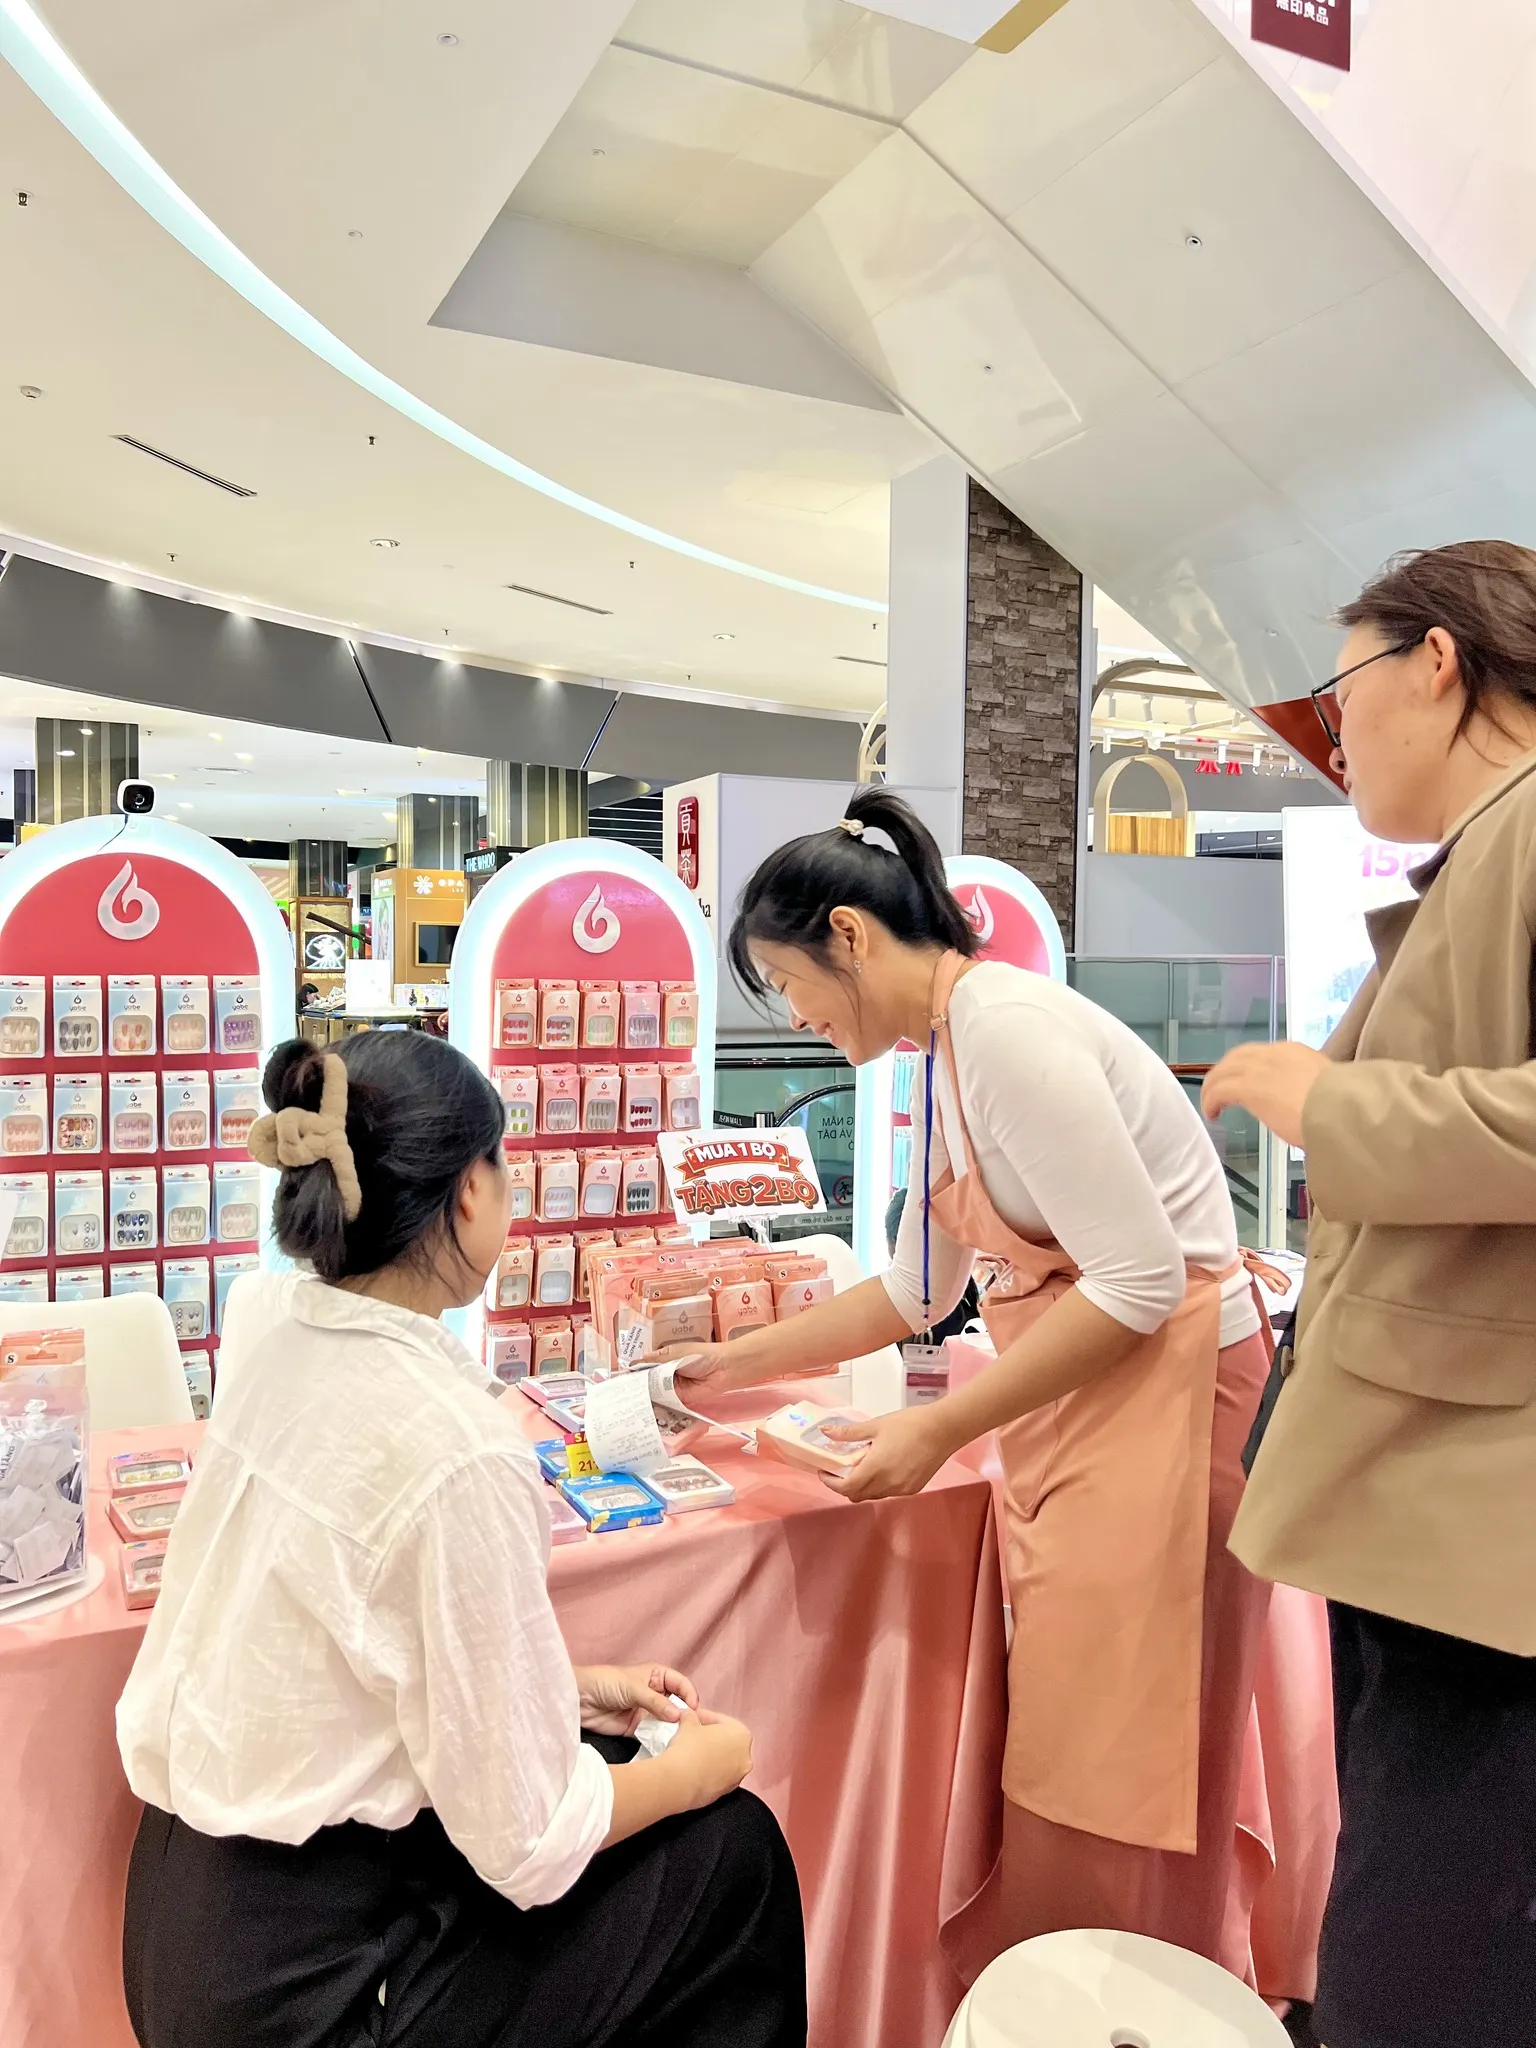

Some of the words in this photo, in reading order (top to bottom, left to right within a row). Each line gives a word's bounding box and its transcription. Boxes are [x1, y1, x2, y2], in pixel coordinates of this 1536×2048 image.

[465, 857, 478, 872] THE
[478, 852, 496, 871] WHOO
[694, 1144, 736, 1163] MUA
[738, 1143, 749, 1157] 1
[749, 1142, 776, 1160] BỘ
[675, 1179, 751, 1215] TẶNG
[748, 1174, 780, 1206] 2
[774, 1173, 818, 1209] BỘ
[737, 1306, 758, 1316] yabe
[672, 1325, 694, 1335] yabe
[7, 1354, 15, 1364] S
